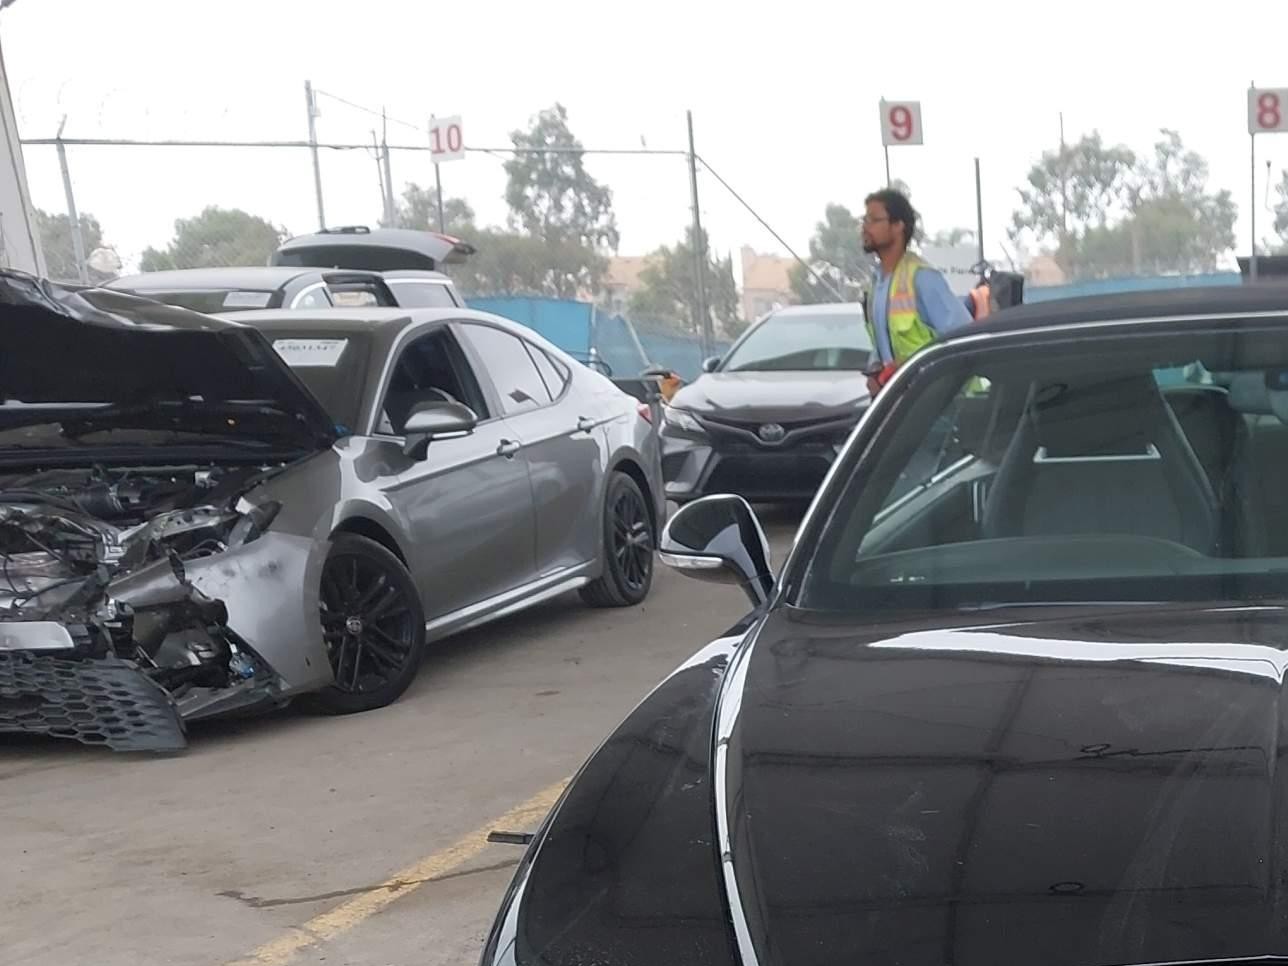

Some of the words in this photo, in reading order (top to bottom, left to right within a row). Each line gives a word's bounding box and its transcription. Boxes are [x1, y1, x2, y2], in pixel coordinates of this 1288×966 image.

[890, 105, 912, 141] 9
[1258, 92, 1280, 129] 8
[431, 125, 462, 154] 10
